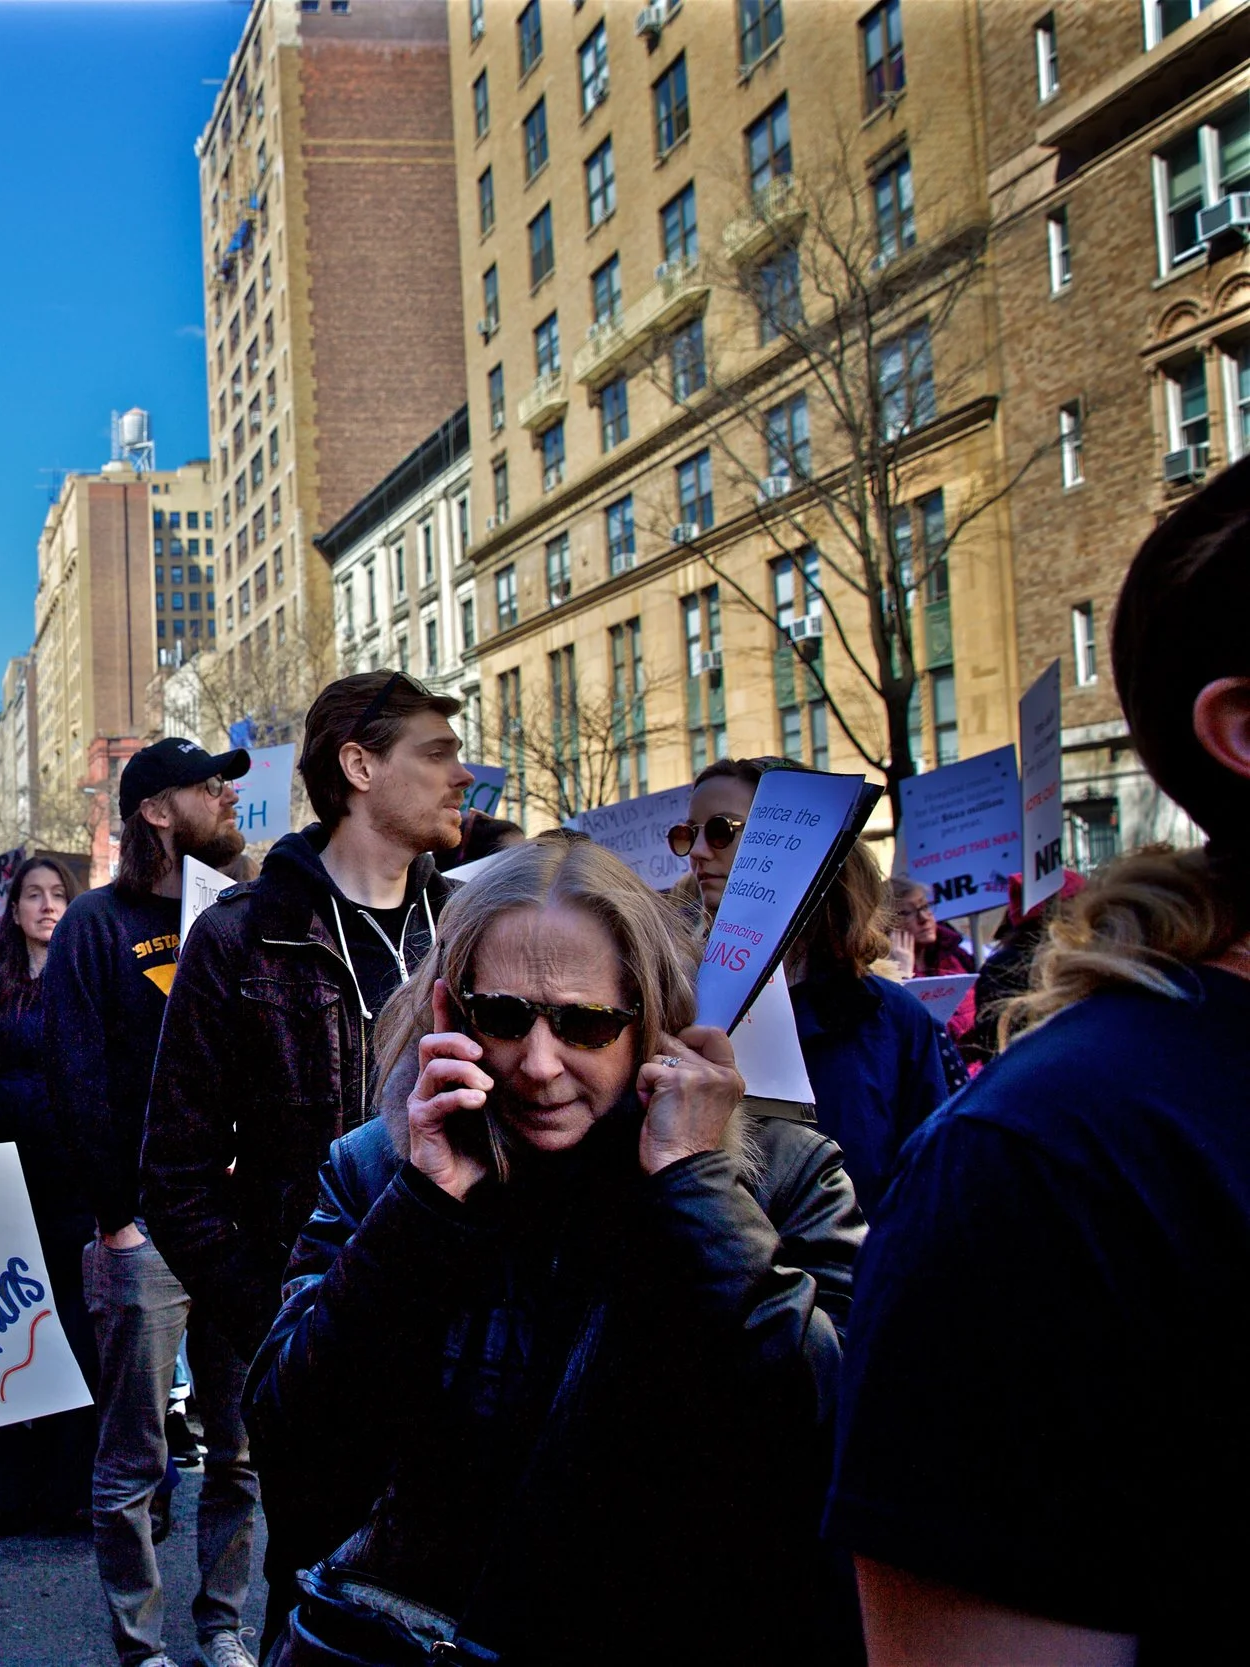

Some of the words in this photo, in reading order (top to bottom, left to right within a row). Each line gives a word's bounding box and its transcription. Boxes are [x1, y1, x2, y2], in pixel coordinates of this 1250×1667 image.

[794, 807, 821, 827] the
[744, 829, 784, 847] easier
[784, 835, 802, 851] to
[912, 852, 942, 868] VOTE
[942, 844, 968, 861] OUT
[968, 837, 992, 853] THE
[992, 829, 1019, 846] NRA
[734, 855, 756, 874] gun
[758, 855, 774, 873] is
[703, 940, 751, 972] UNS
